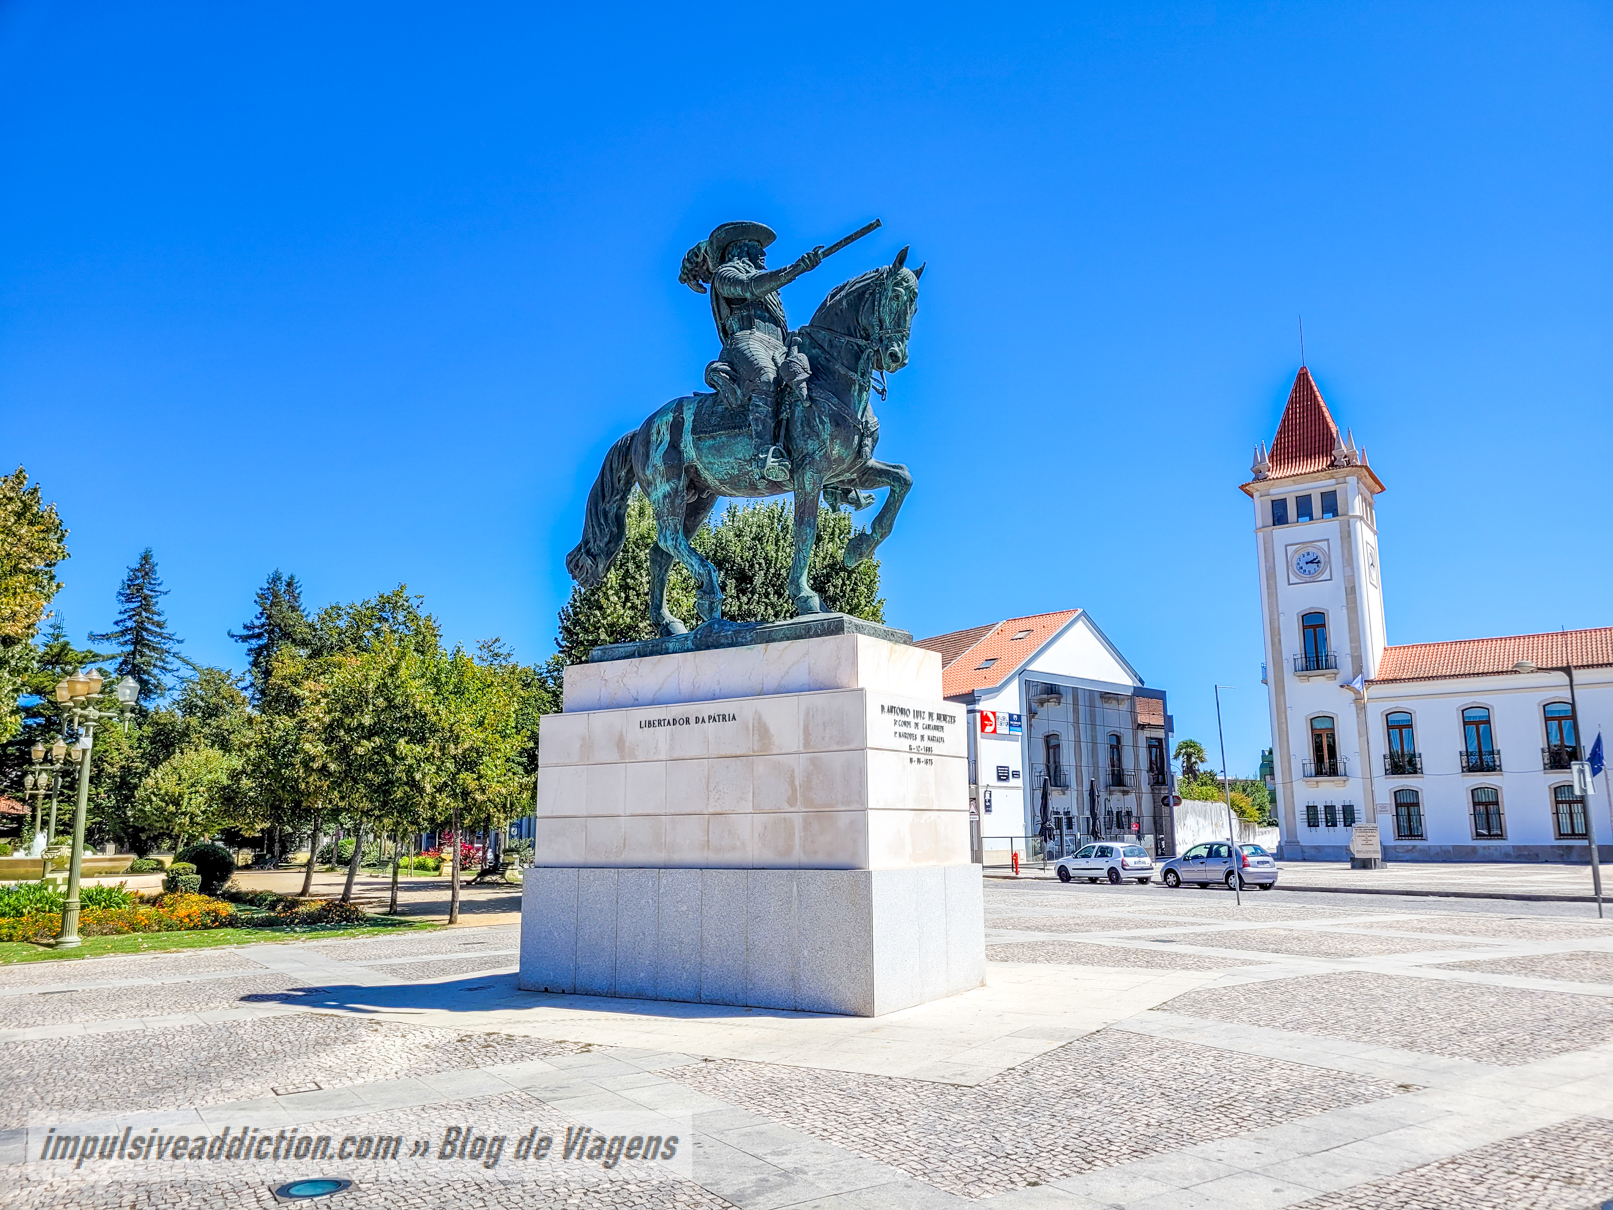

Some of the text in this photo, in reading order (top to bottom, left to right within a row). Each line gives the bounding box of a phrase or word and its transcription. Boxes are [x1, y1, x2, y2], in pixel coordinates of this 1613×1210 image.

[639, 713, 737, 729] LIBERTADOR DA PÁTRIA
[913, 709, 926, 720] LUIZ
[928, 711, 935, 722] DE
